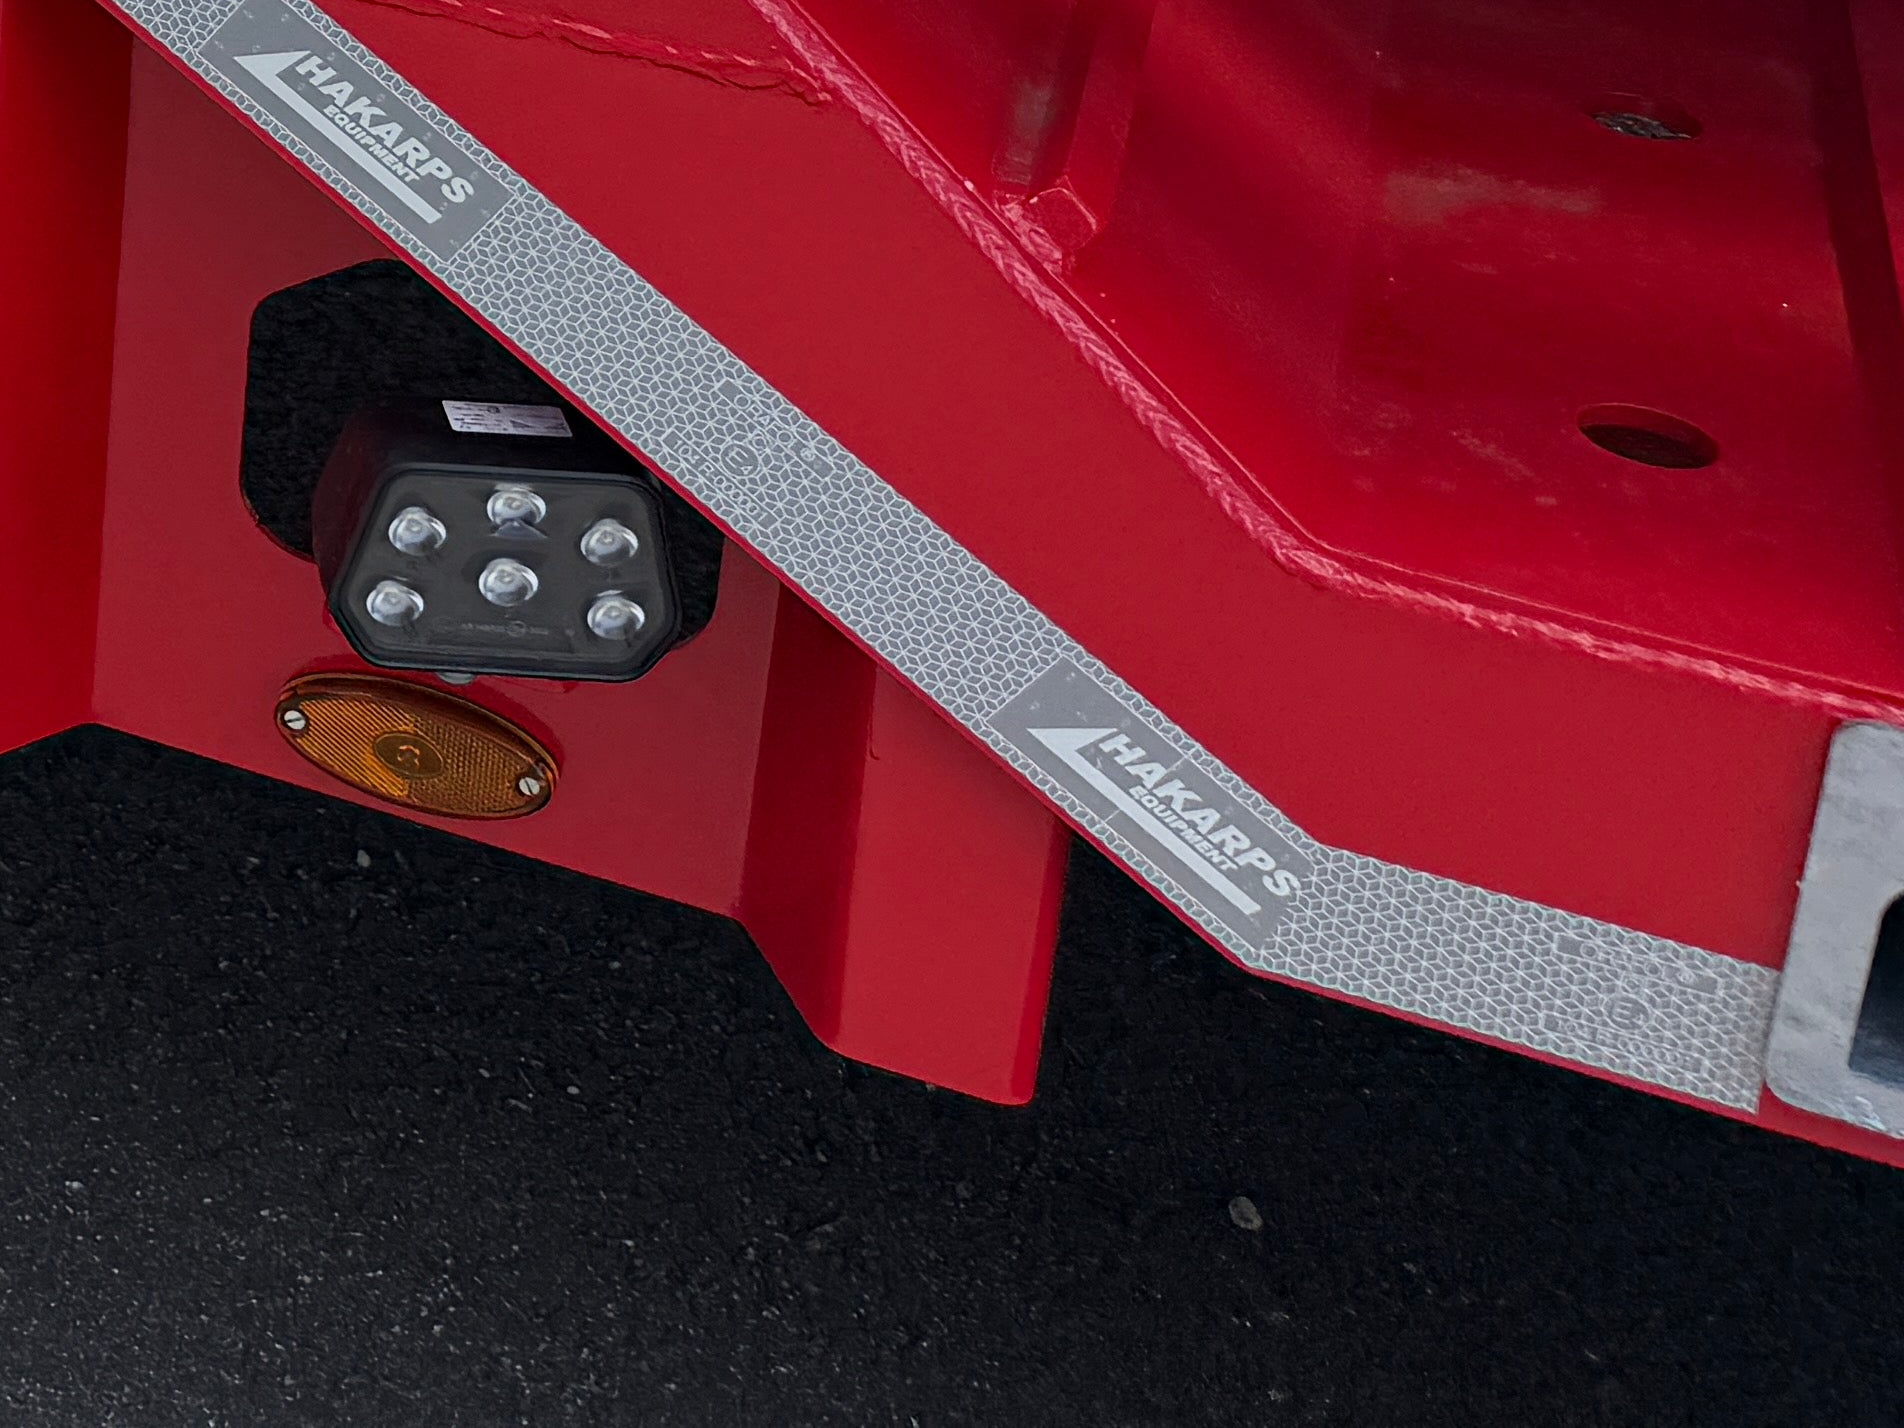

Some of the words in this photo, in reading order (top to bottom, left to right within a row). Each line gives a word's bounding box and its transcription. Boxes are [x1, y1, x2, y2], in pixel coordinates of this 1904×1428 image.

[295, 55, 474, 203] HAKARPS
[323, 104, 420, 183] EQUIPMENT
[1098, 734, 1302, 897] HAKARPS
[1128, 785, 1239, 872] EQUIPMENT
